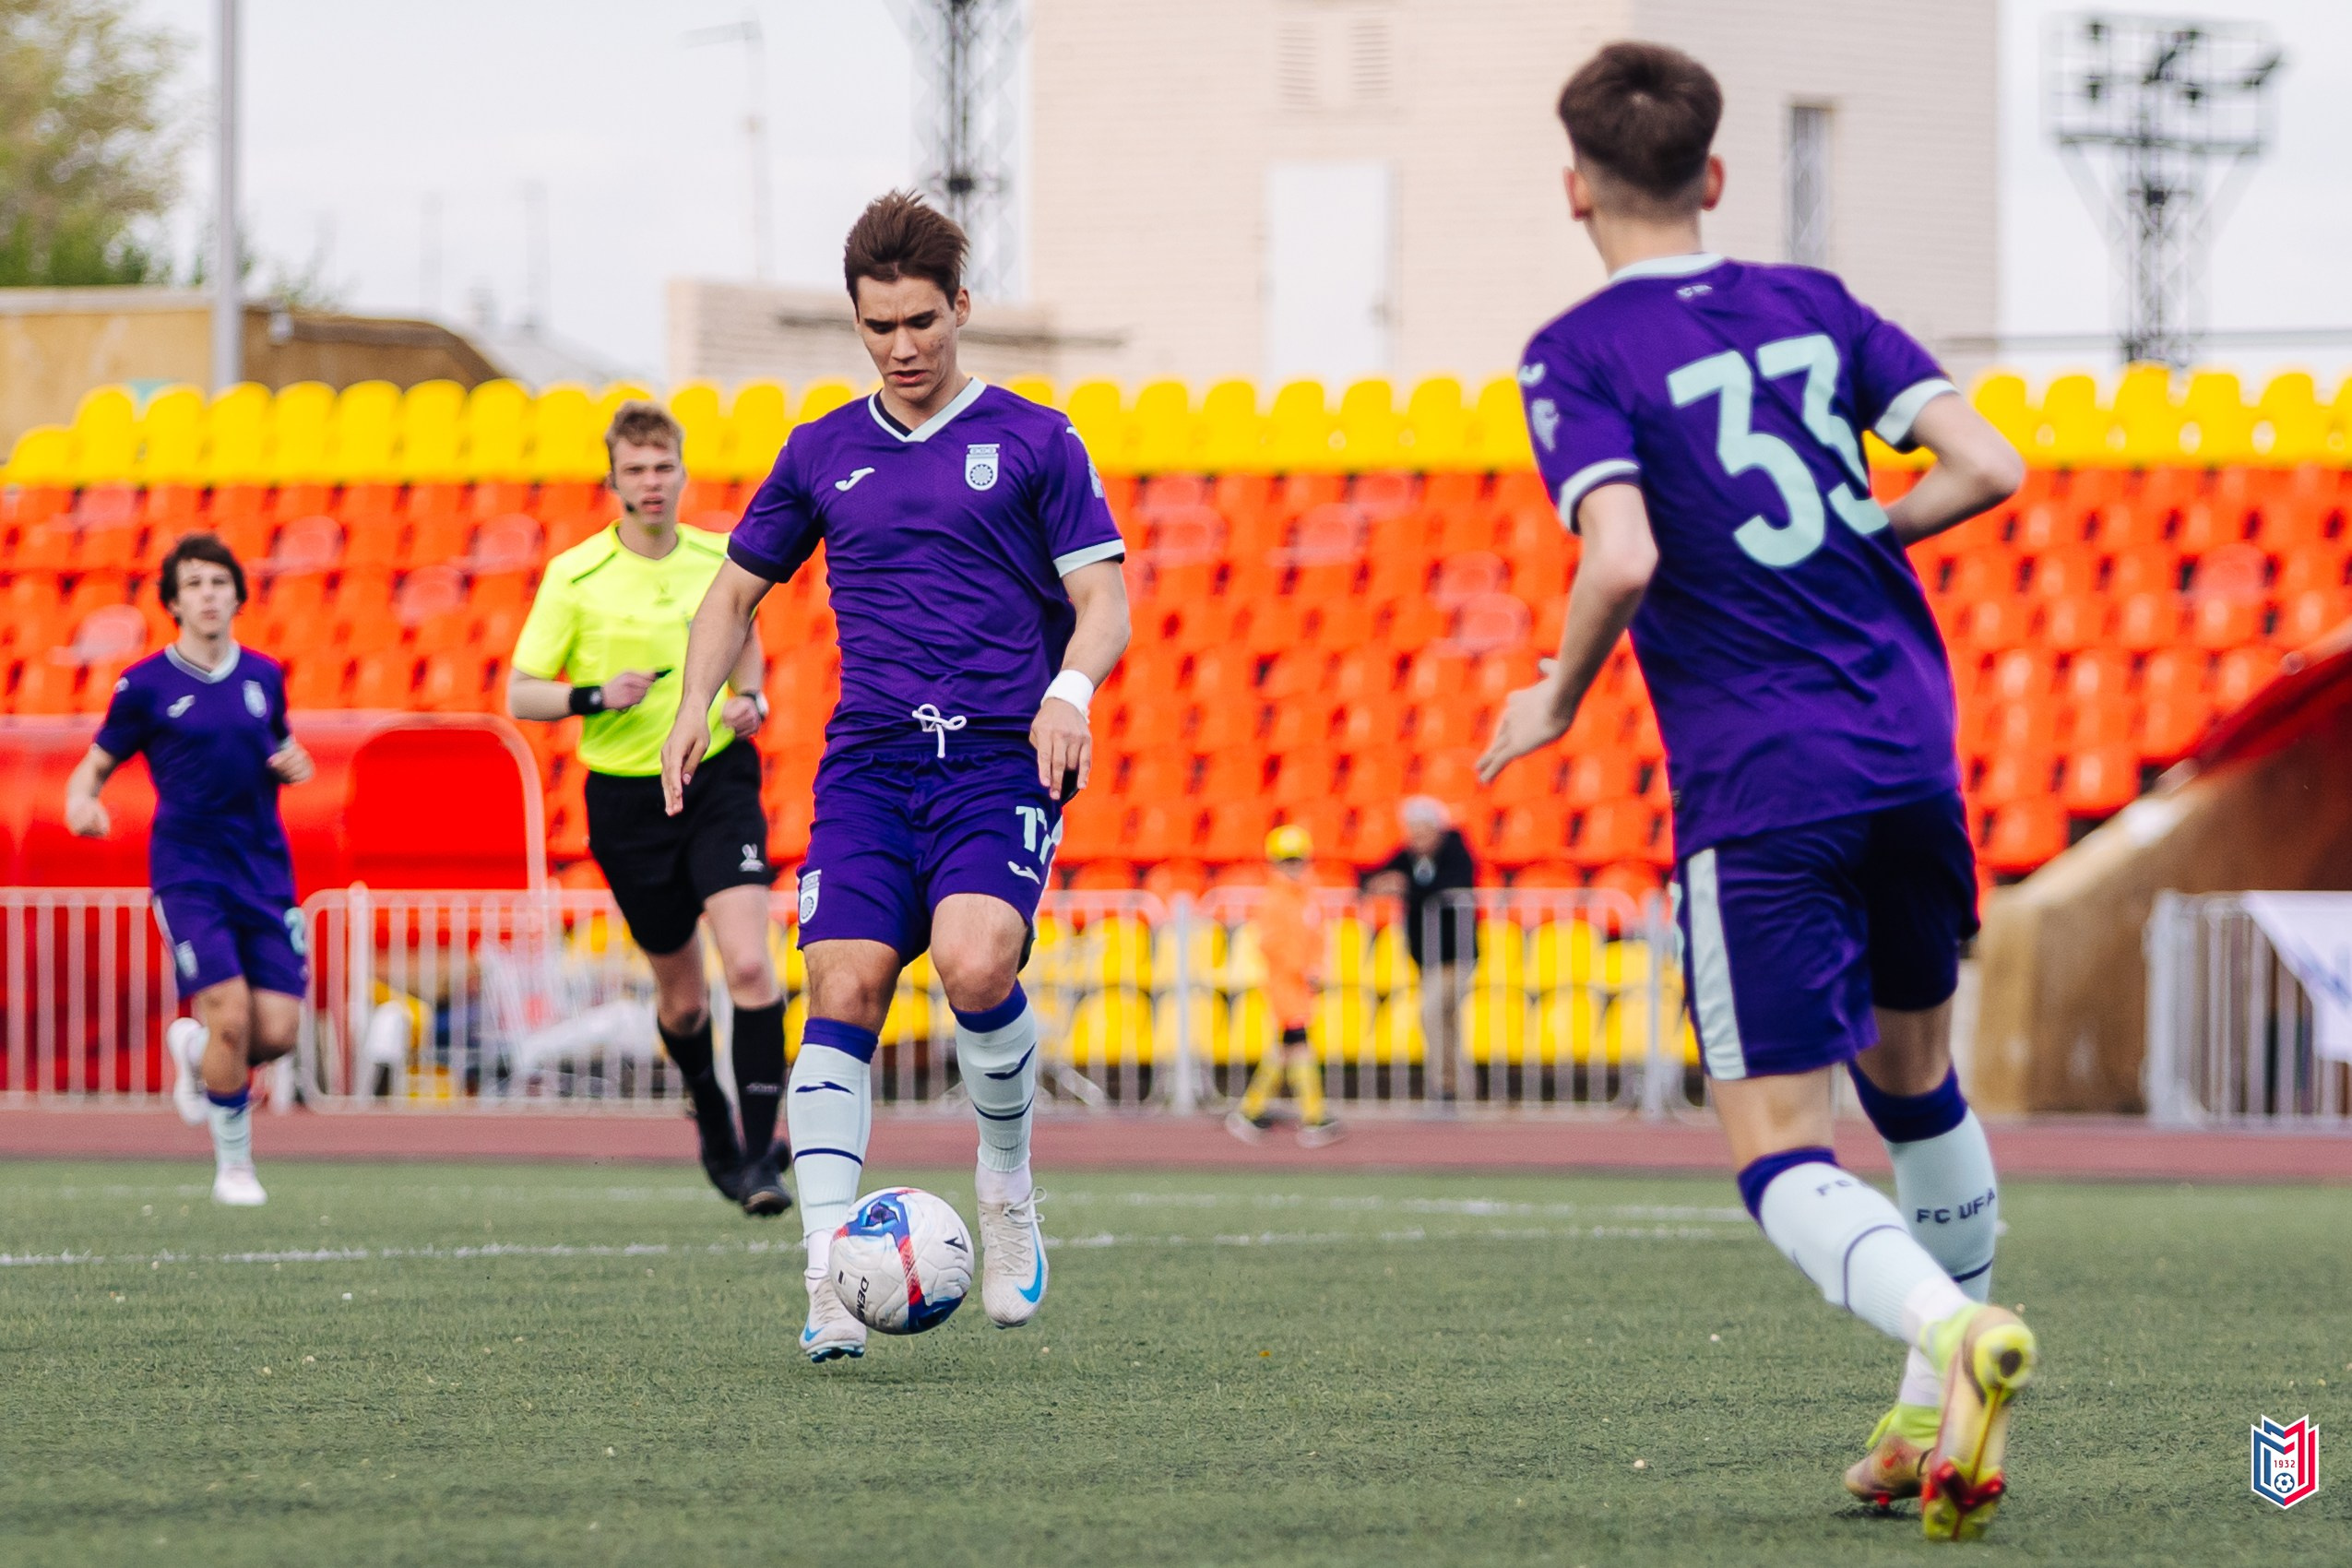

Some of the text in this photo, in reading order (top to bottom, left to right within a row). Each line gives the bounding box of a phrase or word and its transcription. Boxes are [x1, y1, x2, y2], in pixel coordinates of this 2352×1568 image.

[1667, 333, 1890, 567] 33
[1917, 1187, 1995, 1224] FC UFA
